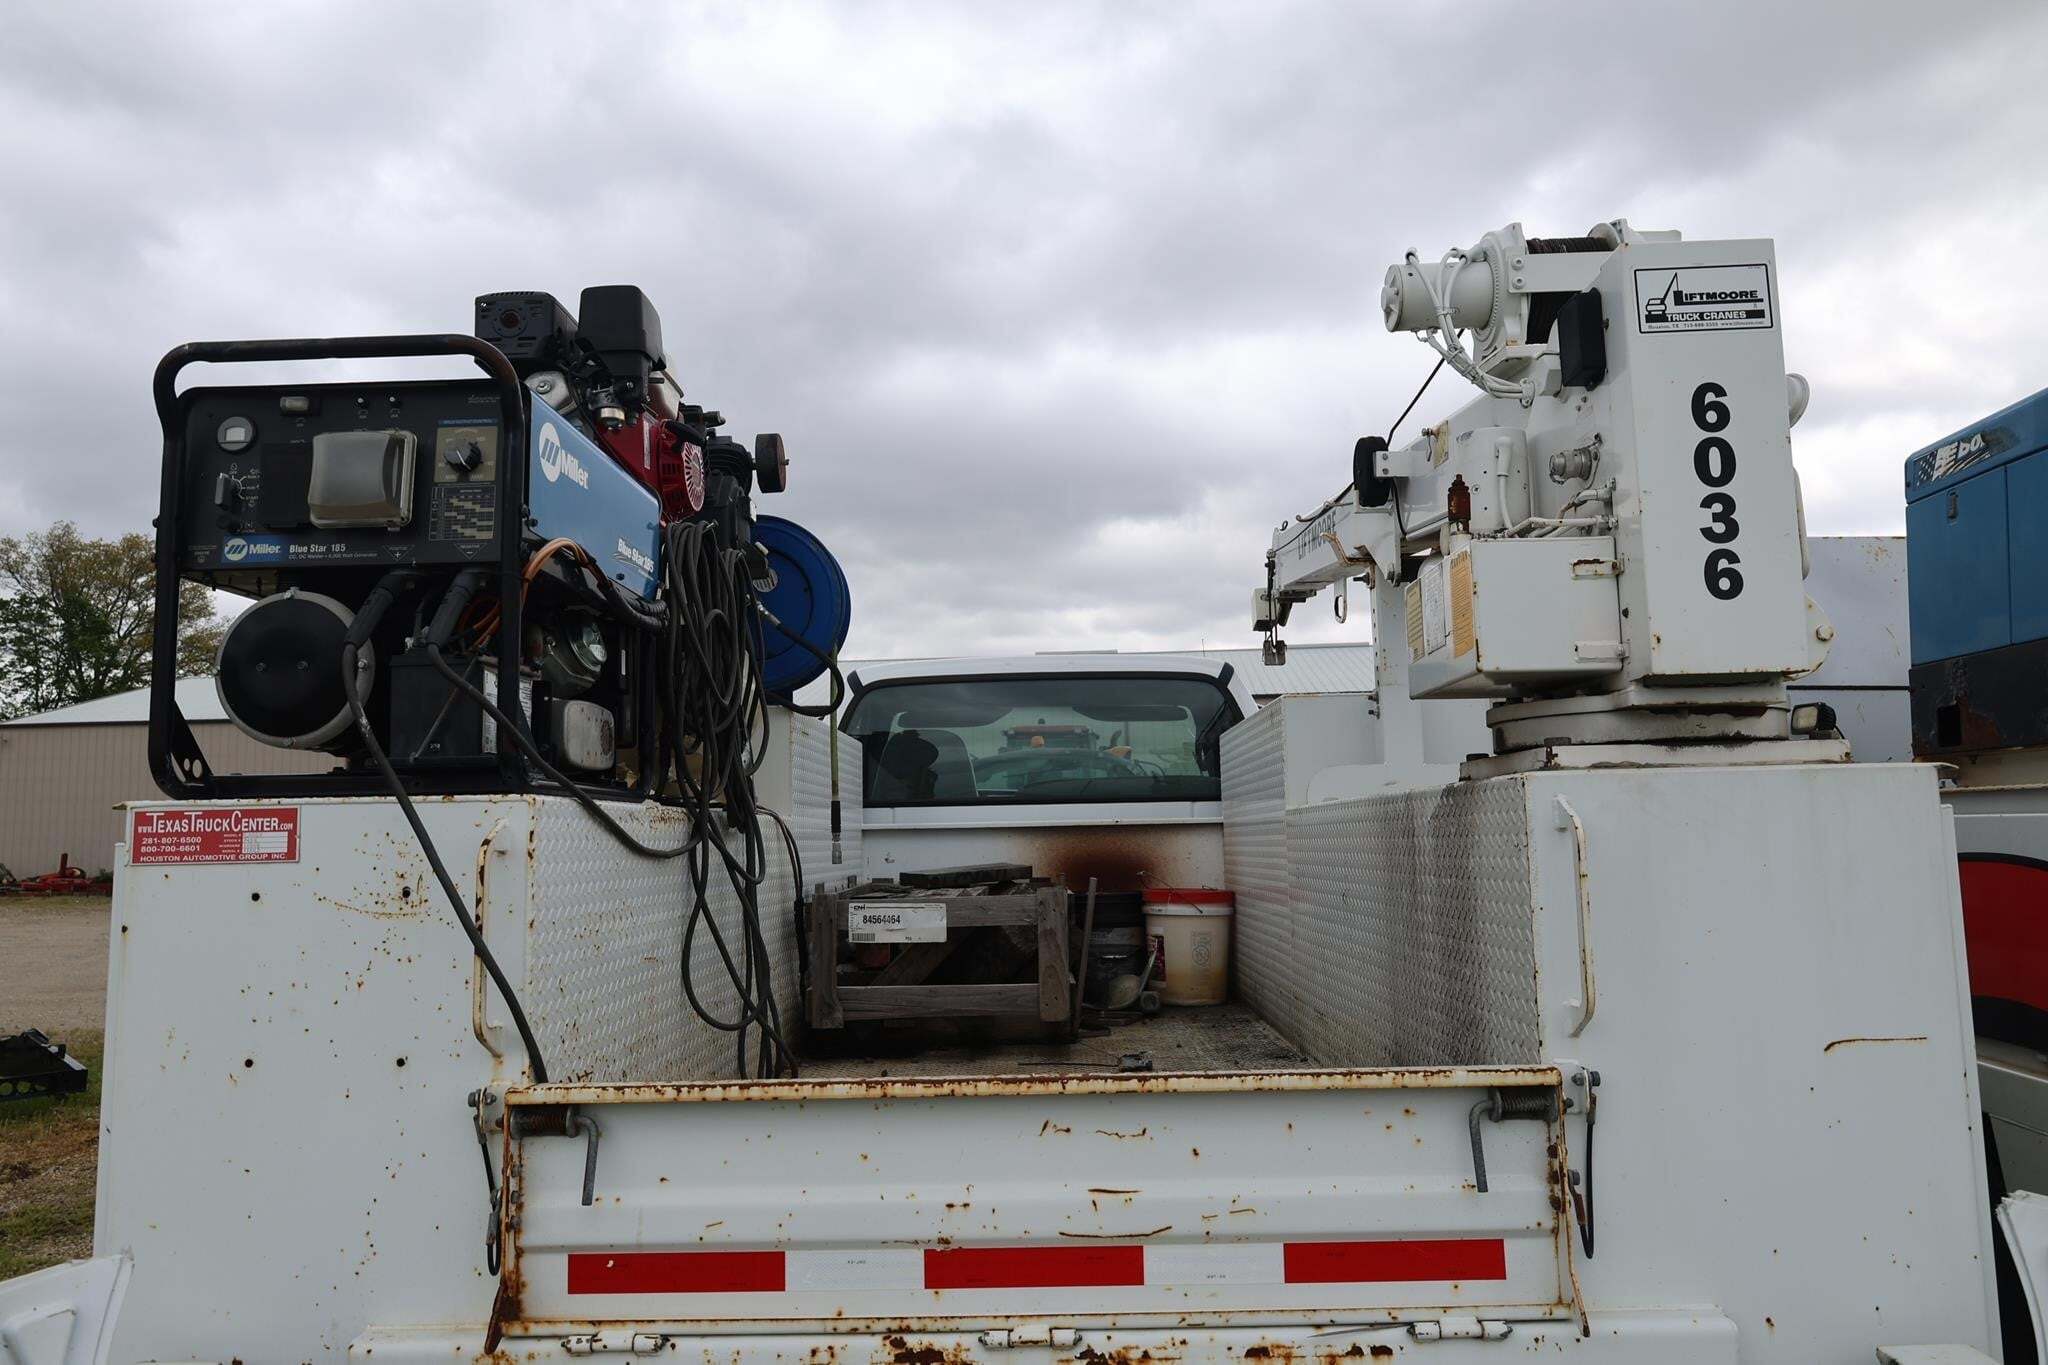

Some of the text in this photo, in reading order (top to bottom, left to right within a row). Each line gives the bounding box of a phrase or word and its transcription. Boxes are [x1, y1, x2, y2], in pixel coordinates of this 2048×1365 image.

[1673, 290, 1763, 306] LIFTMOORE
[1667, 311, 1747, 321] TRUCK CRANES
[561, 449, 589, 490] Miller
[1691, 382, 1744, 600] 6036
[249, 544, 281, 554] Miller
[289, 545, 308, 553] Blue
[310, 544, 326, 552] Star
[617, 538, 631, 559] Blue
[631, 547, 645, 566] Star
[142, 836, 202, 845] 281-807-6500
[182, 854, 237, 862] AUTOMOTIVE
